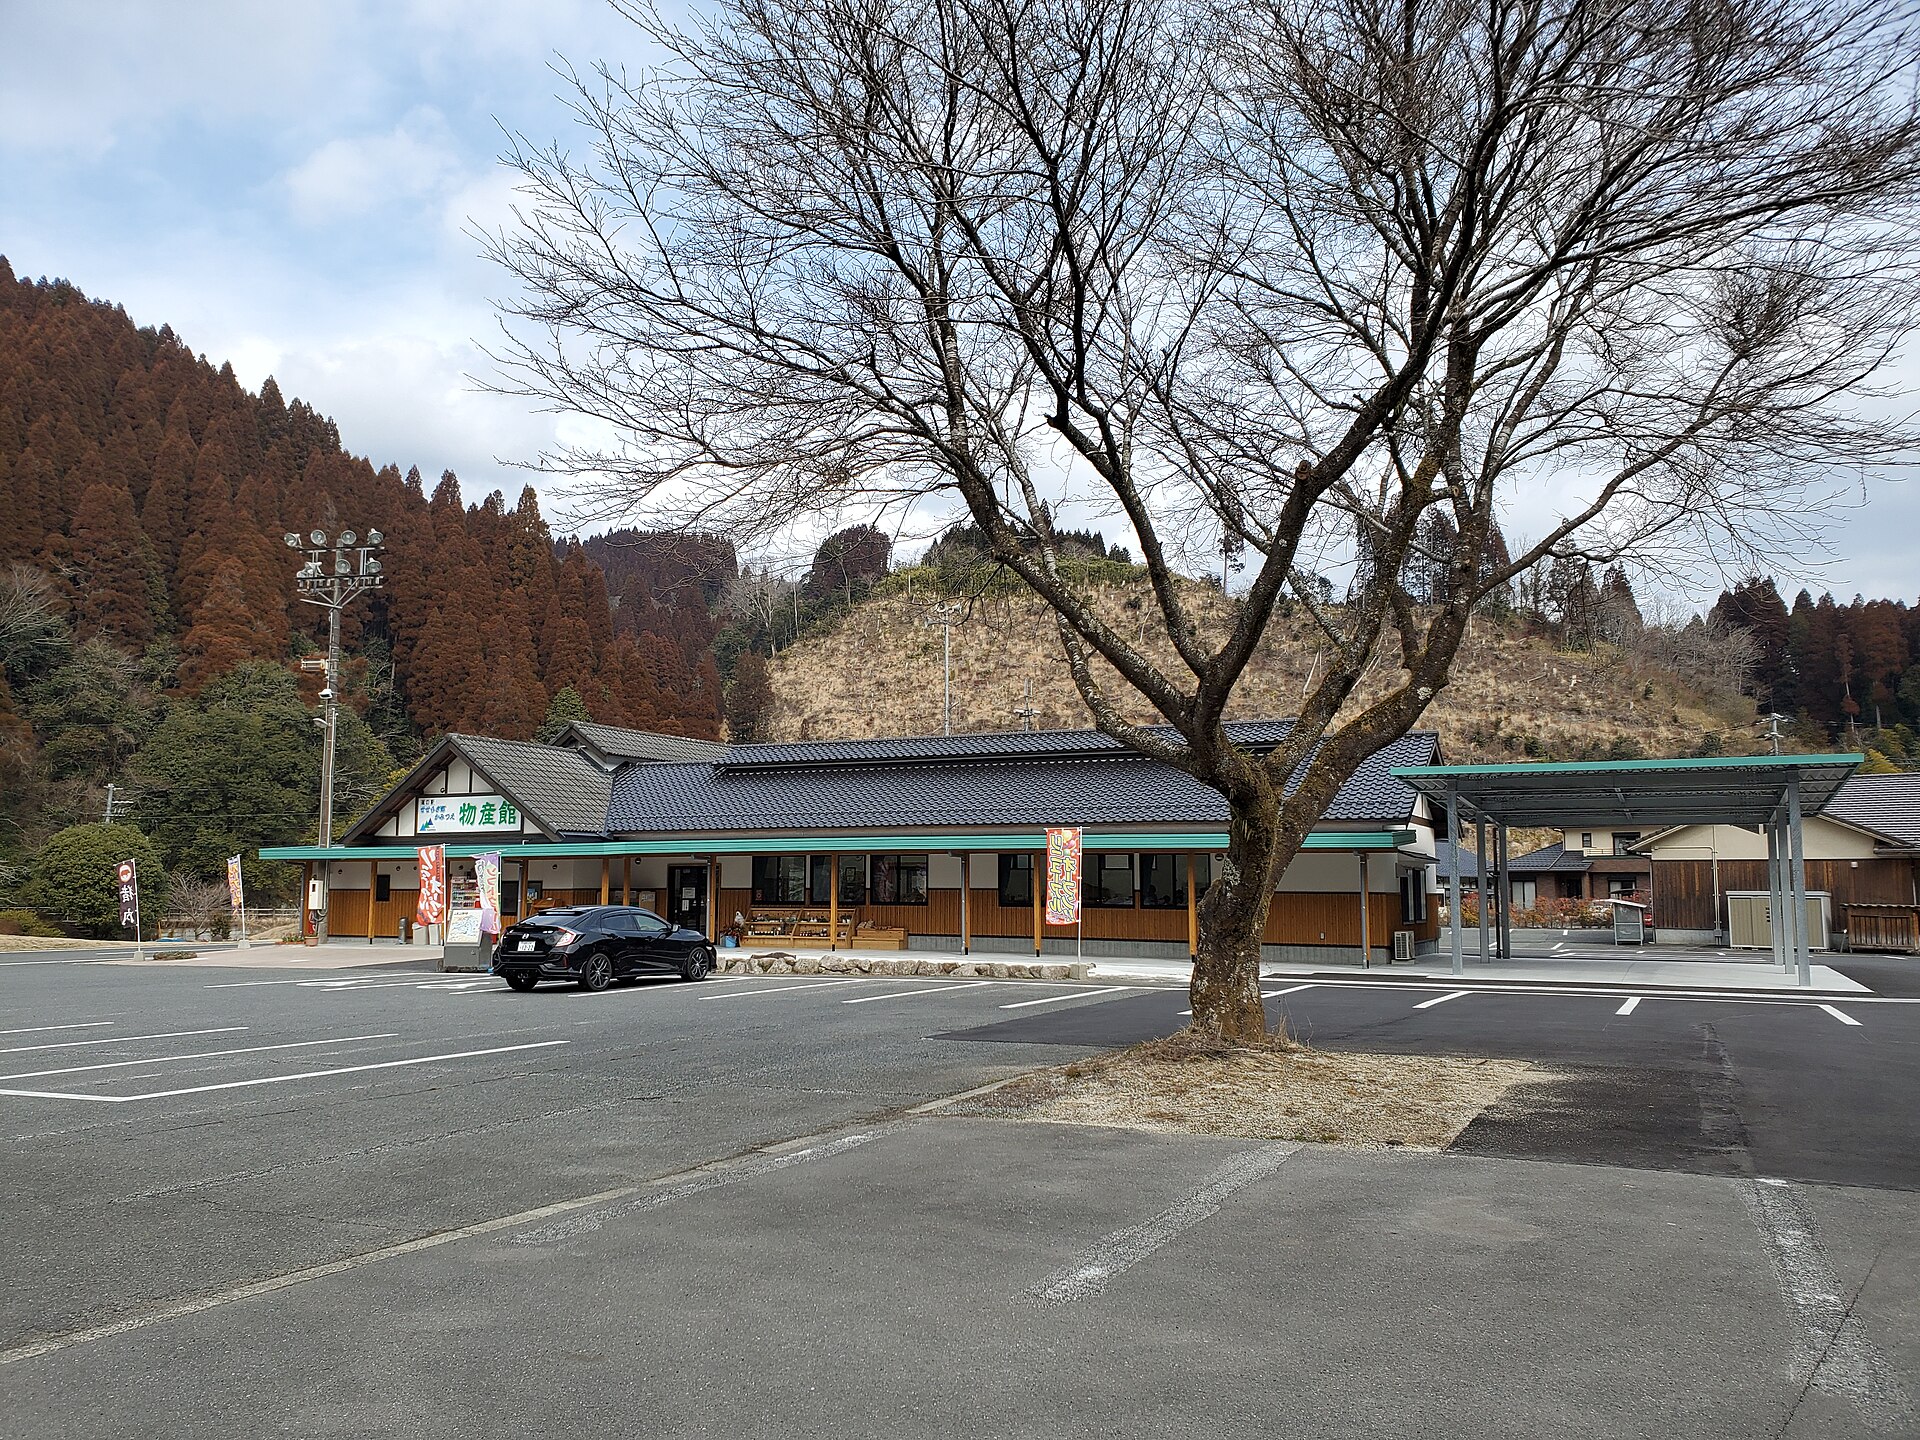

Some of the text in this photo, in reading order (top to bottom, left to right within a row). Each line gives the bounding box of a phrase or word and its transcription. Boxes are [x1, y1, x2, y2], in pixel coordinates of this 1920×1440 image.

[434, 813, 455, 821] かみつえ
[459, 801, 517, 826] 物産館
